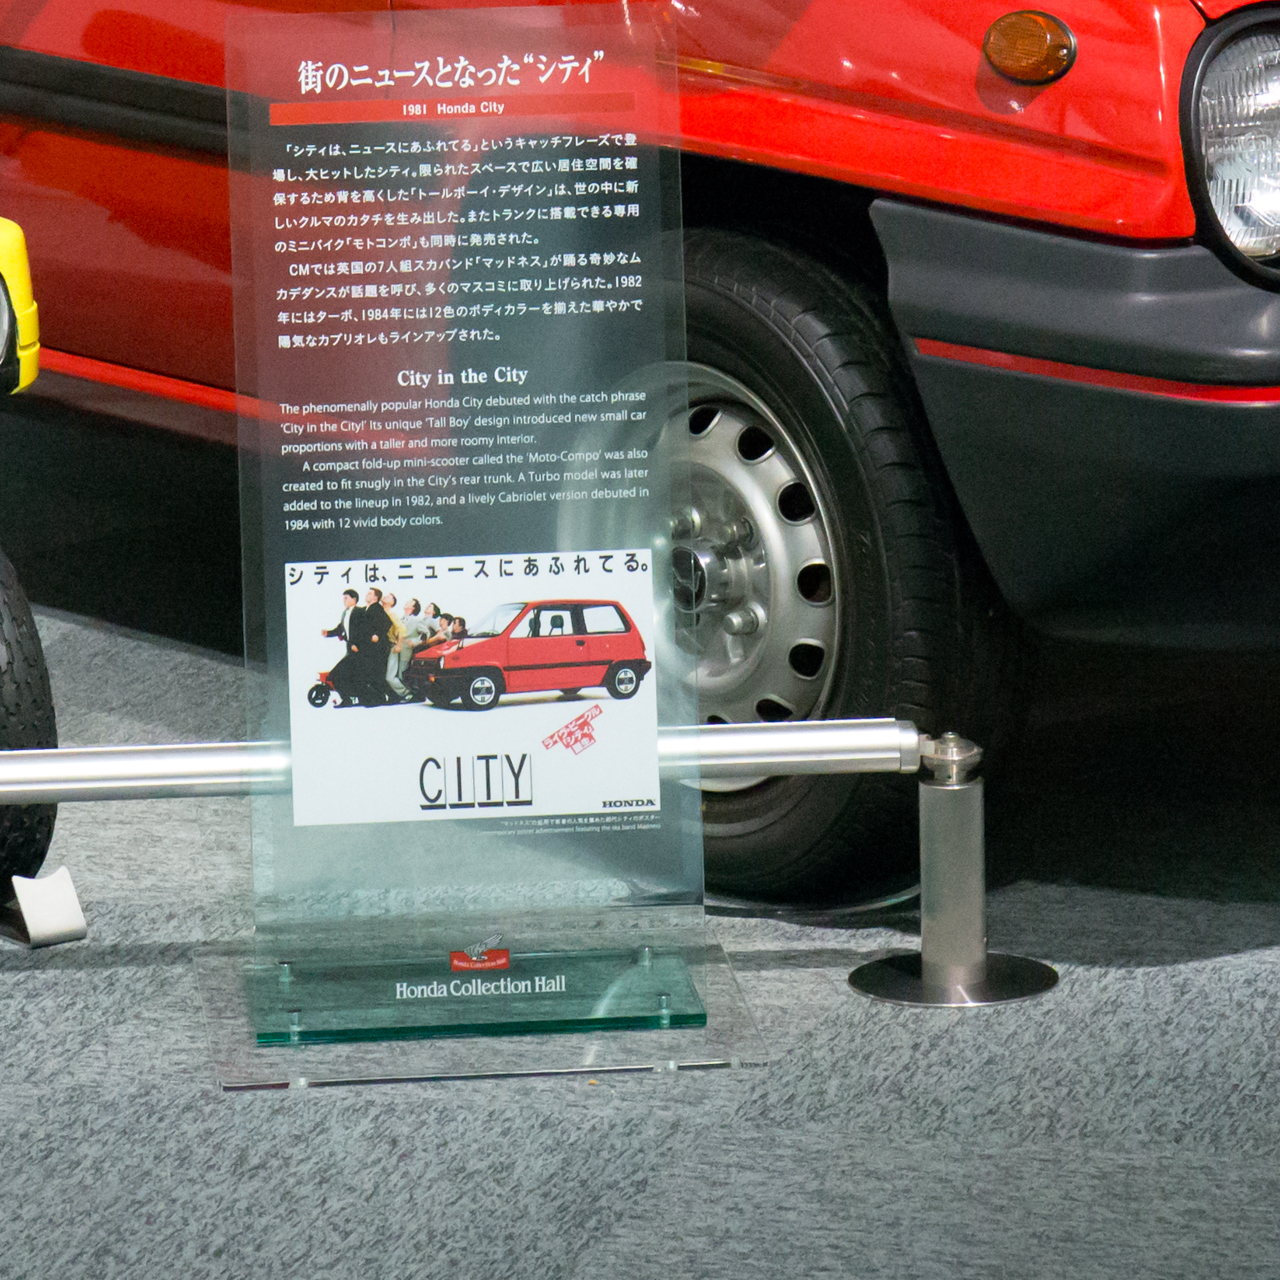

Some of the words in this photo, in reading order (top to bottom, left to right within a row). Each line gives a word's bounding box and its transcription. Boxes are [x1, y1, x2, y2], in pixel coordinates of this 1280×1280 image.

[402, 103, 428, 116] 1981
[437, 102, 475, 115] Honda
[480, 102, 505, 116] City
[397, 370, 432, 388] City
[437, 369, 454, 384] in
[460, 368, 488, 384] the
[494, 366, 528, 385] City
[279, 403, 300, 414] The
[302, 400, 379, 415] phenomenally
[380, 399, 422, 412] popular
[424, 398, 460, 409] Honda
[462, 396, 483, 409] City
[485, 394, 530, 406] debuted
[532, 393, 557, 404] with
[559, 393, 577, 404] the
[579, 391, 608, 403] catch
[610, 391, 646, 404] phrase
[306, 422, 317, 433] in
[319, 421, 338, 432] the
[369, 420, 382, 430] Its
[384, 420, 423, 431] unique
[473, 416, 510, 428] design
[512, 413, 571, 424] introduced
[574, 414, 597, 422] new
[600, 410, 628, 421] small
[630, 412, 647, 421] car
[281, 442, 343, 455] proportions
[344, 439, 368, 450] with
[370, 441, 377, 450] a
[379, 438, 406, 449] taller
[407, 437, 428, 448] and
[430, 438, 458, 447] more
[460, 437, 494, 447] roomy
[496, 434, 537, 444] interior.
[302, 461, 311, 472] A
[312, 461, 359, 472] compact
[361, 458, 401, 470] fold-up
[403, 457, 470, 467] mini-scooter
[472, 454, 503, 465] called
[505, 453, 523, 464] the
[604, 451, 625, 460] was
[626, 448, 648, 459] also
[282, 480, 324, 492] created
[326, 481, 338, 490] to
[340, 478, 352, 490] fit
[355, 477, 391, 491] snugly
[393, 477, 404, 487] in
[406, 476, 425, 487] the
[459, 476, 481, 485] rear
[483, 473, 515, 484] trunk.
[517, 472, 526, 482] A
[527, 471, 560, 482] Turbo
[563, 469, 598, 480] model
[600, 471, 621, 479] was
[624, 468, 649, 478] later
[282, 500, 317, 511] added
[319, 500, 332, 510] to
[334, 499, 352, 509] the
[354, 498, 389, 509] lineup
[391, 496, 402, 507] in
[405, 495, 433, 506] 1982,
[435, 494, 456, 505] and
[459, 496, 465, 504] a
[468, 493, 496, 505] lively
[497, 491, 546, 503] Cabriolet
[549, 491, 588, 500] version
[590, 487, 636, 498] debuted
[639, 487, 649, 497] in
[284, 519, 310, 531] 1984
[311, 518, 335, 529] with
[338, 518, 351, 528] 12
[352, 517, 378, 528] vivid
[380, 516, 407, 528] body
[409, 515, 443, 525] colors.
[419, 753, 528, 804] CITY
[602, 799, 656, 808] HONDA
[396, 981, 448, 999] Honda
[450, 978, 532, 996] Collection
[534, 975, 566, 993] Hall
